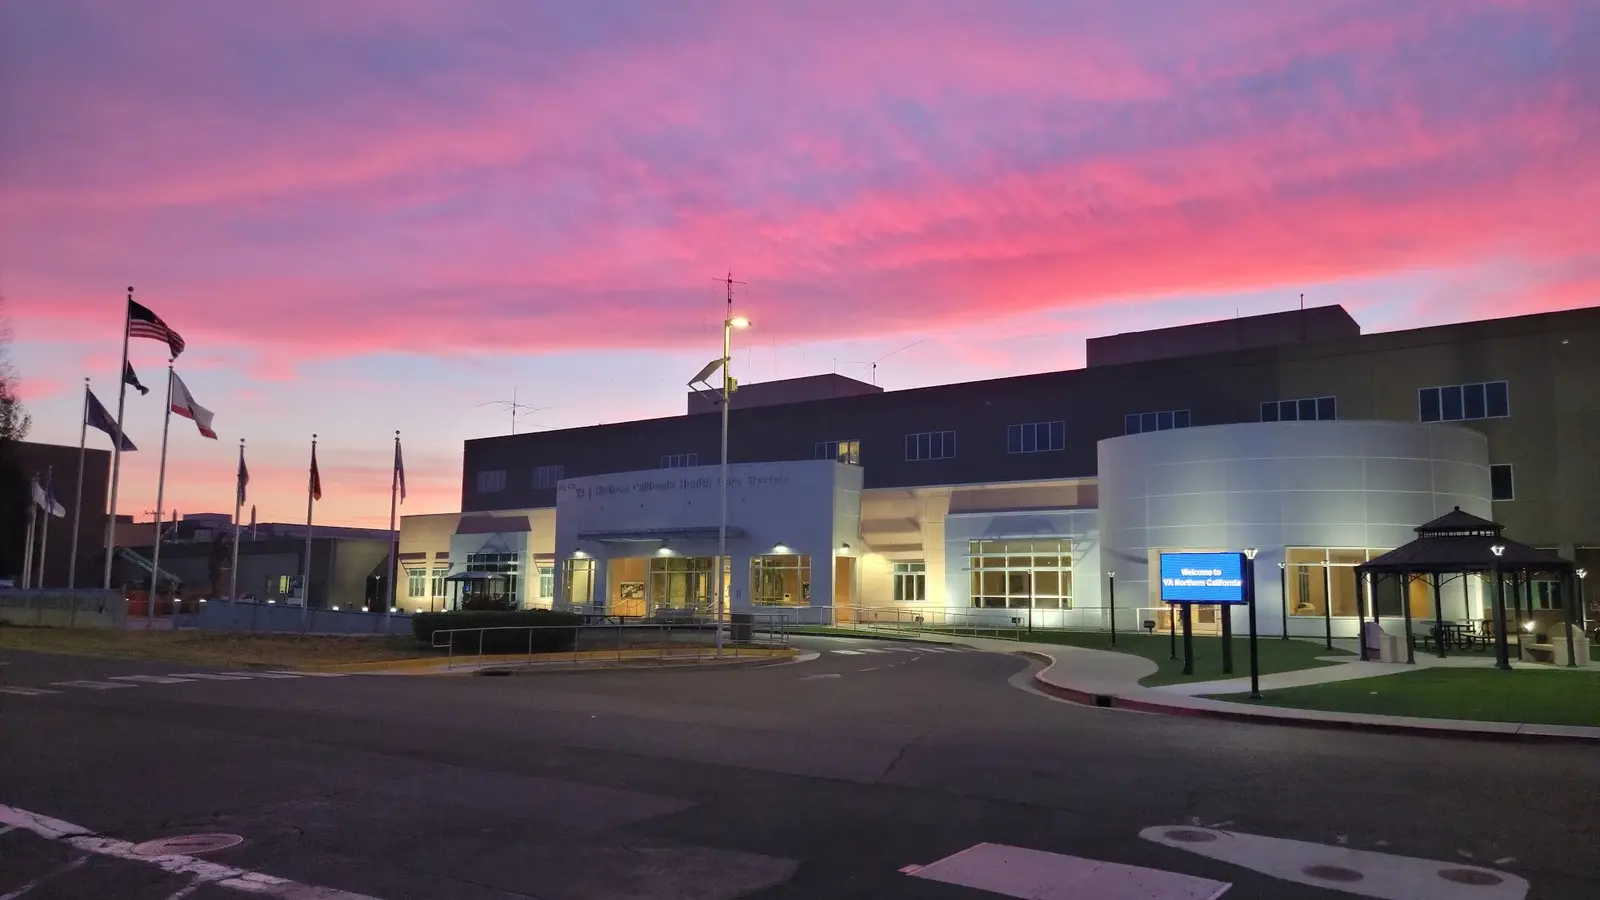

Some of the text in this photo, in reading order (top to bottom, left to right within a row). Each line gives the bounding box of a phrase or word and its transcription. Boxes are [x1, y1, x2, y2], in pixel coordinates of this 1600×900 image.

[1181, 568, 1222, 577] Welcome to
[1163, 578, 1242, 587] VA Northern California
